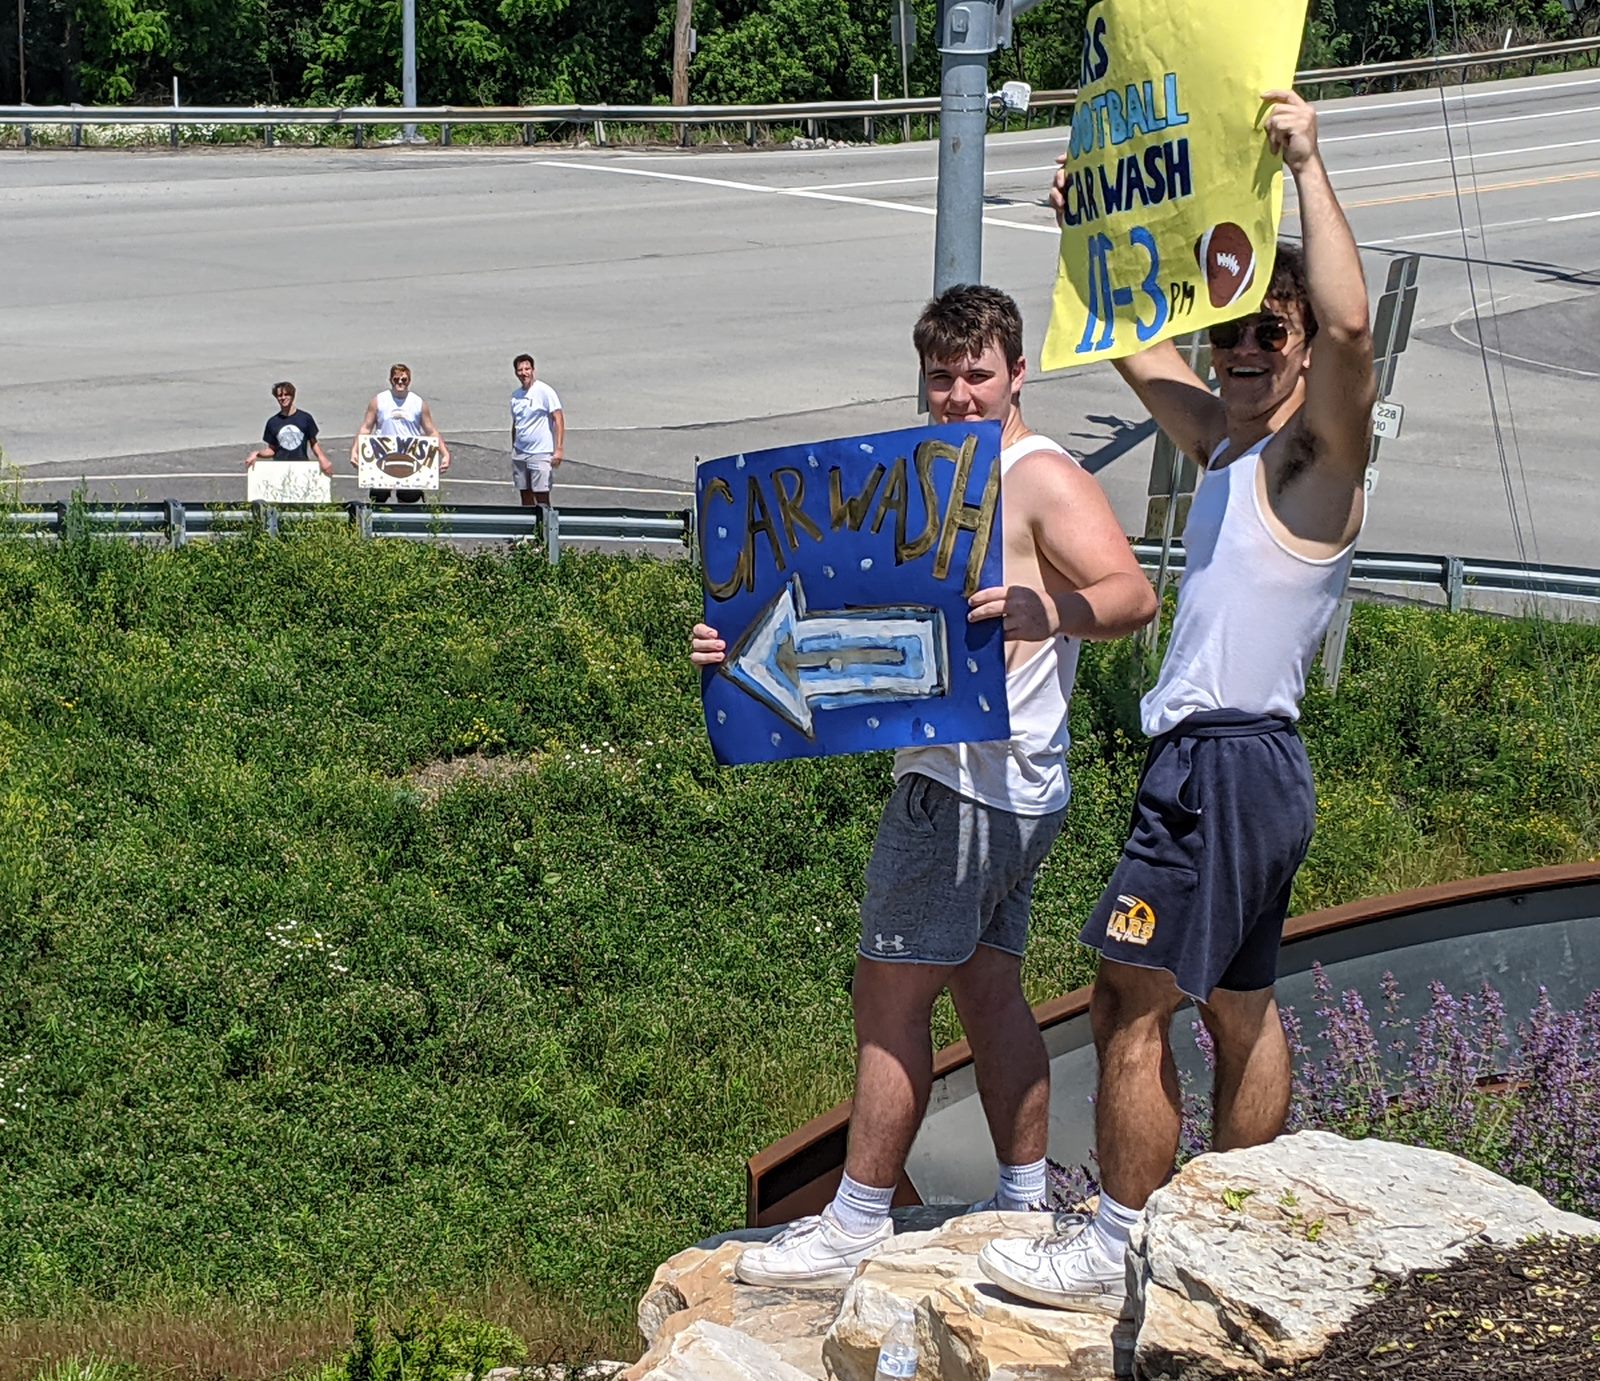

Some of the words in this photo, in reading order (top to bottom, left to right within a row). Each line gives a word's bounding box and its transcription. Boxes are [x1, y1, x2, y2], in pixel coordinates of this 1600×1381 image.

[1079, 17, 1109, 88] RS
[1064, 166, 1099, 226] CAR
[1098, 138, 1192, 215] WASH
[1075, 226, 1169, 354] 11-3
[1168, 281, 1195, 322] PM
[396, 436, 439, 469] WASH
[1377, 407, 1397, 420] 228
[701, 467, 824, 603] CAR
[828, 433, 1001, 599] WASH
